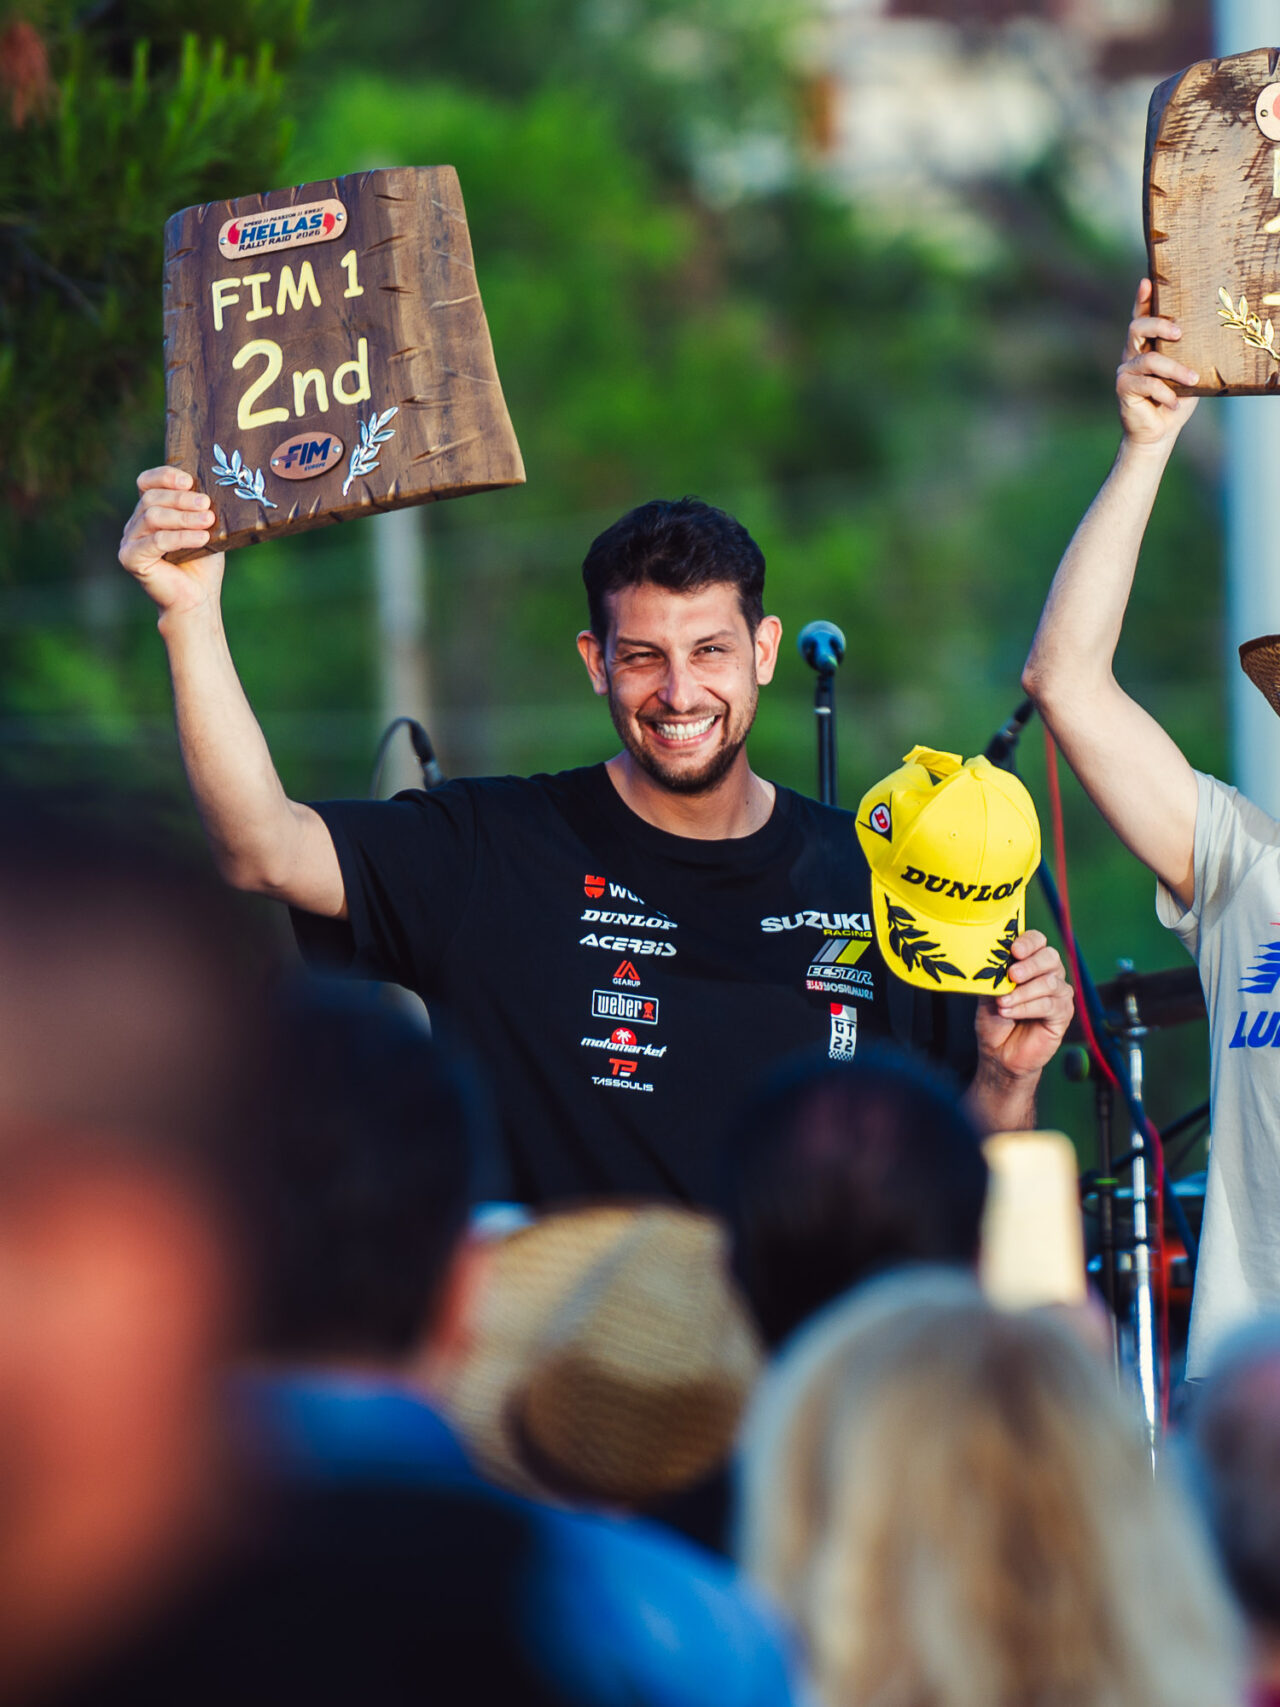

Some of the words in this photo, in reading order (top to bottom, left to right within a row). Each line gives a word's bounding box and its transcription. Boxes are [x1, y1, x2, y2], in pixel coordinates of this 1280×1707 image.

[240, 213, 323, 245] HELLAS
[238, 239, 265, 252] RALLY
[268, 234, 291, 245] RAID
[296, 229, 320, 240] 2026
[211, 260, 322, 331] FIM
[340, 249, 364, 299] 1
[232, 337, 372, 431] 2nd
[280, 437, 332, 469] FIM
[580, 909, 678, 930] DUNLOP
[760, 910, 872, 933] SUZUKI
[823, 929, 873, 938] RACING
[612, 977, 641, 987] GEARUP
[807, 965, 874, 986] ECSTAR
[597, 994, 642, 1018] weber
[580, 1037, 668, 1058] motomarket
[833, 1036, 853, 1053] 22
[591, 1076, 654, 1092] TASSOULIS
